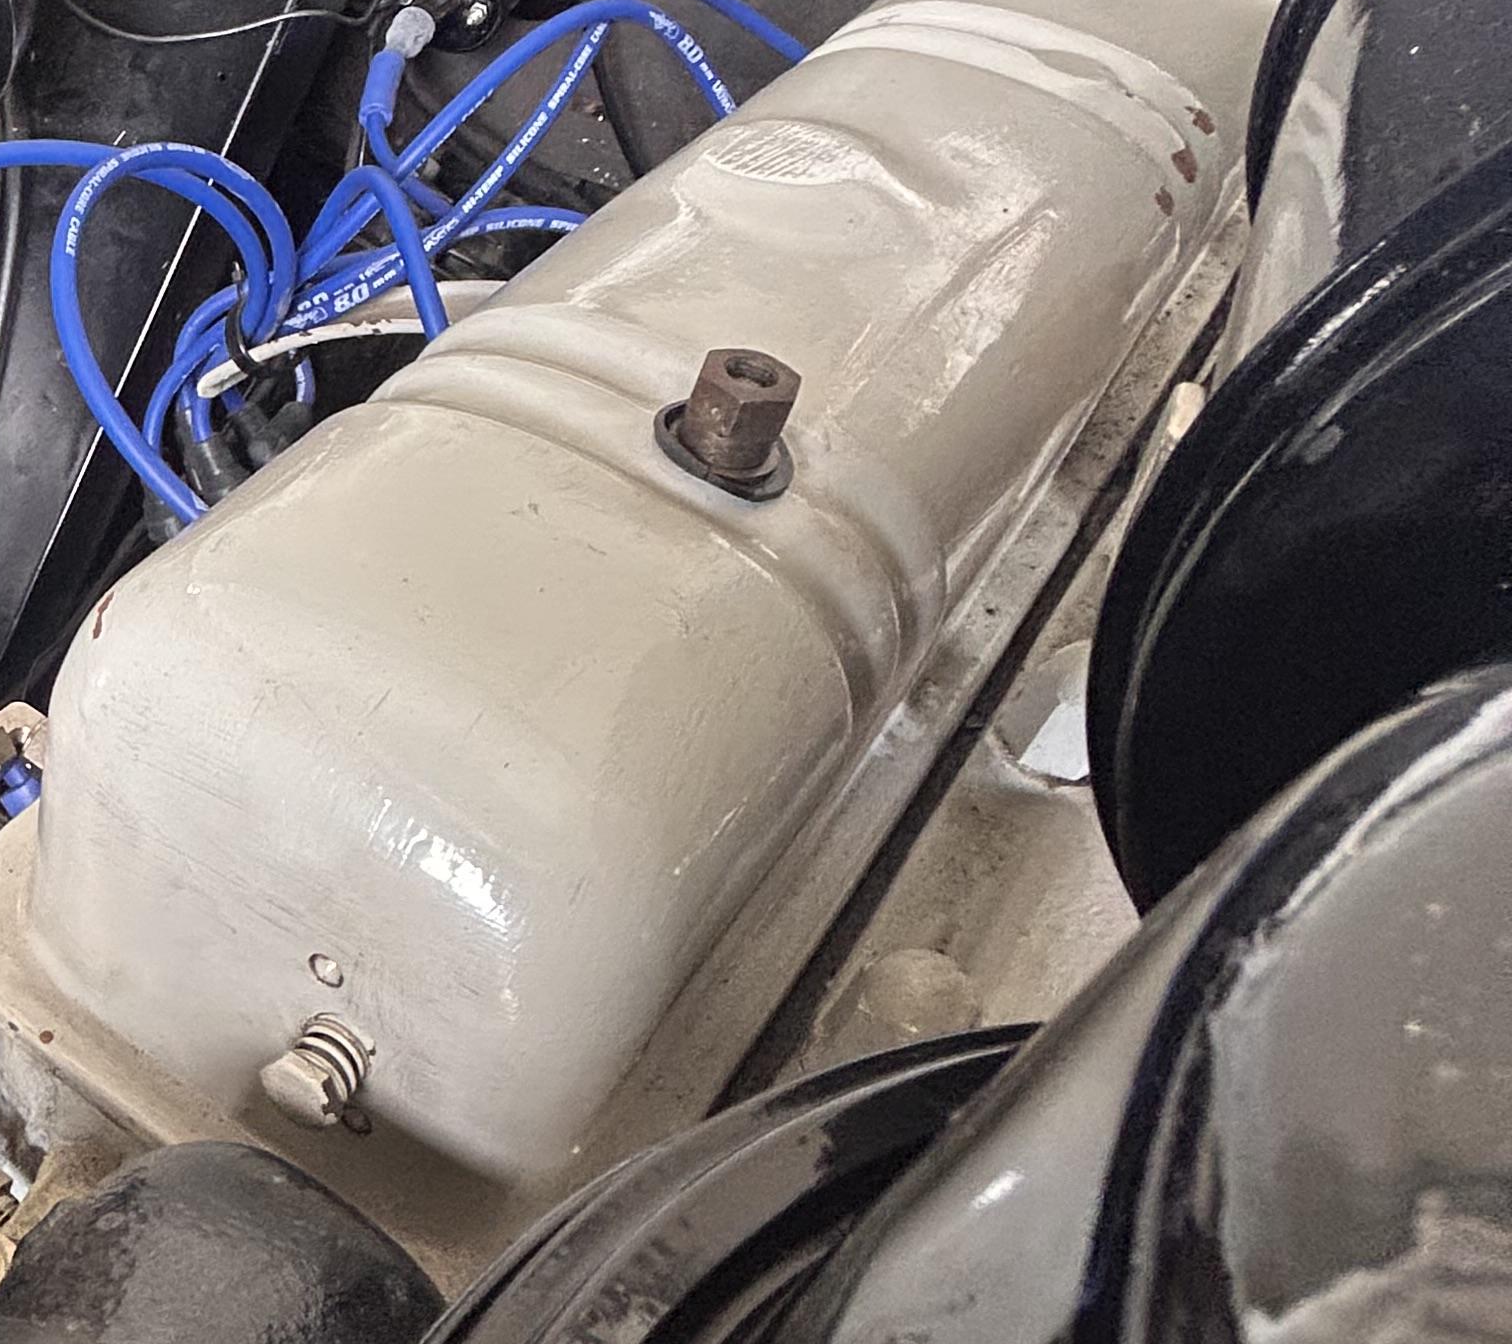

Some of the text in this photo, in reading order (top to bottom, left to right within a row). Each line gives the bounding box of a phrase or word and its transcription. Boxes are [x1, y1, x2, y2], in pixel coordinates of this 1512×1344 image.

[65, 216, 81, 257] CABLE
[333, 283, 370, 313] 8.0
[505, 111, 549, 165] SILICONE
[547, 44, 593, 110] SPIRAL-CORE
